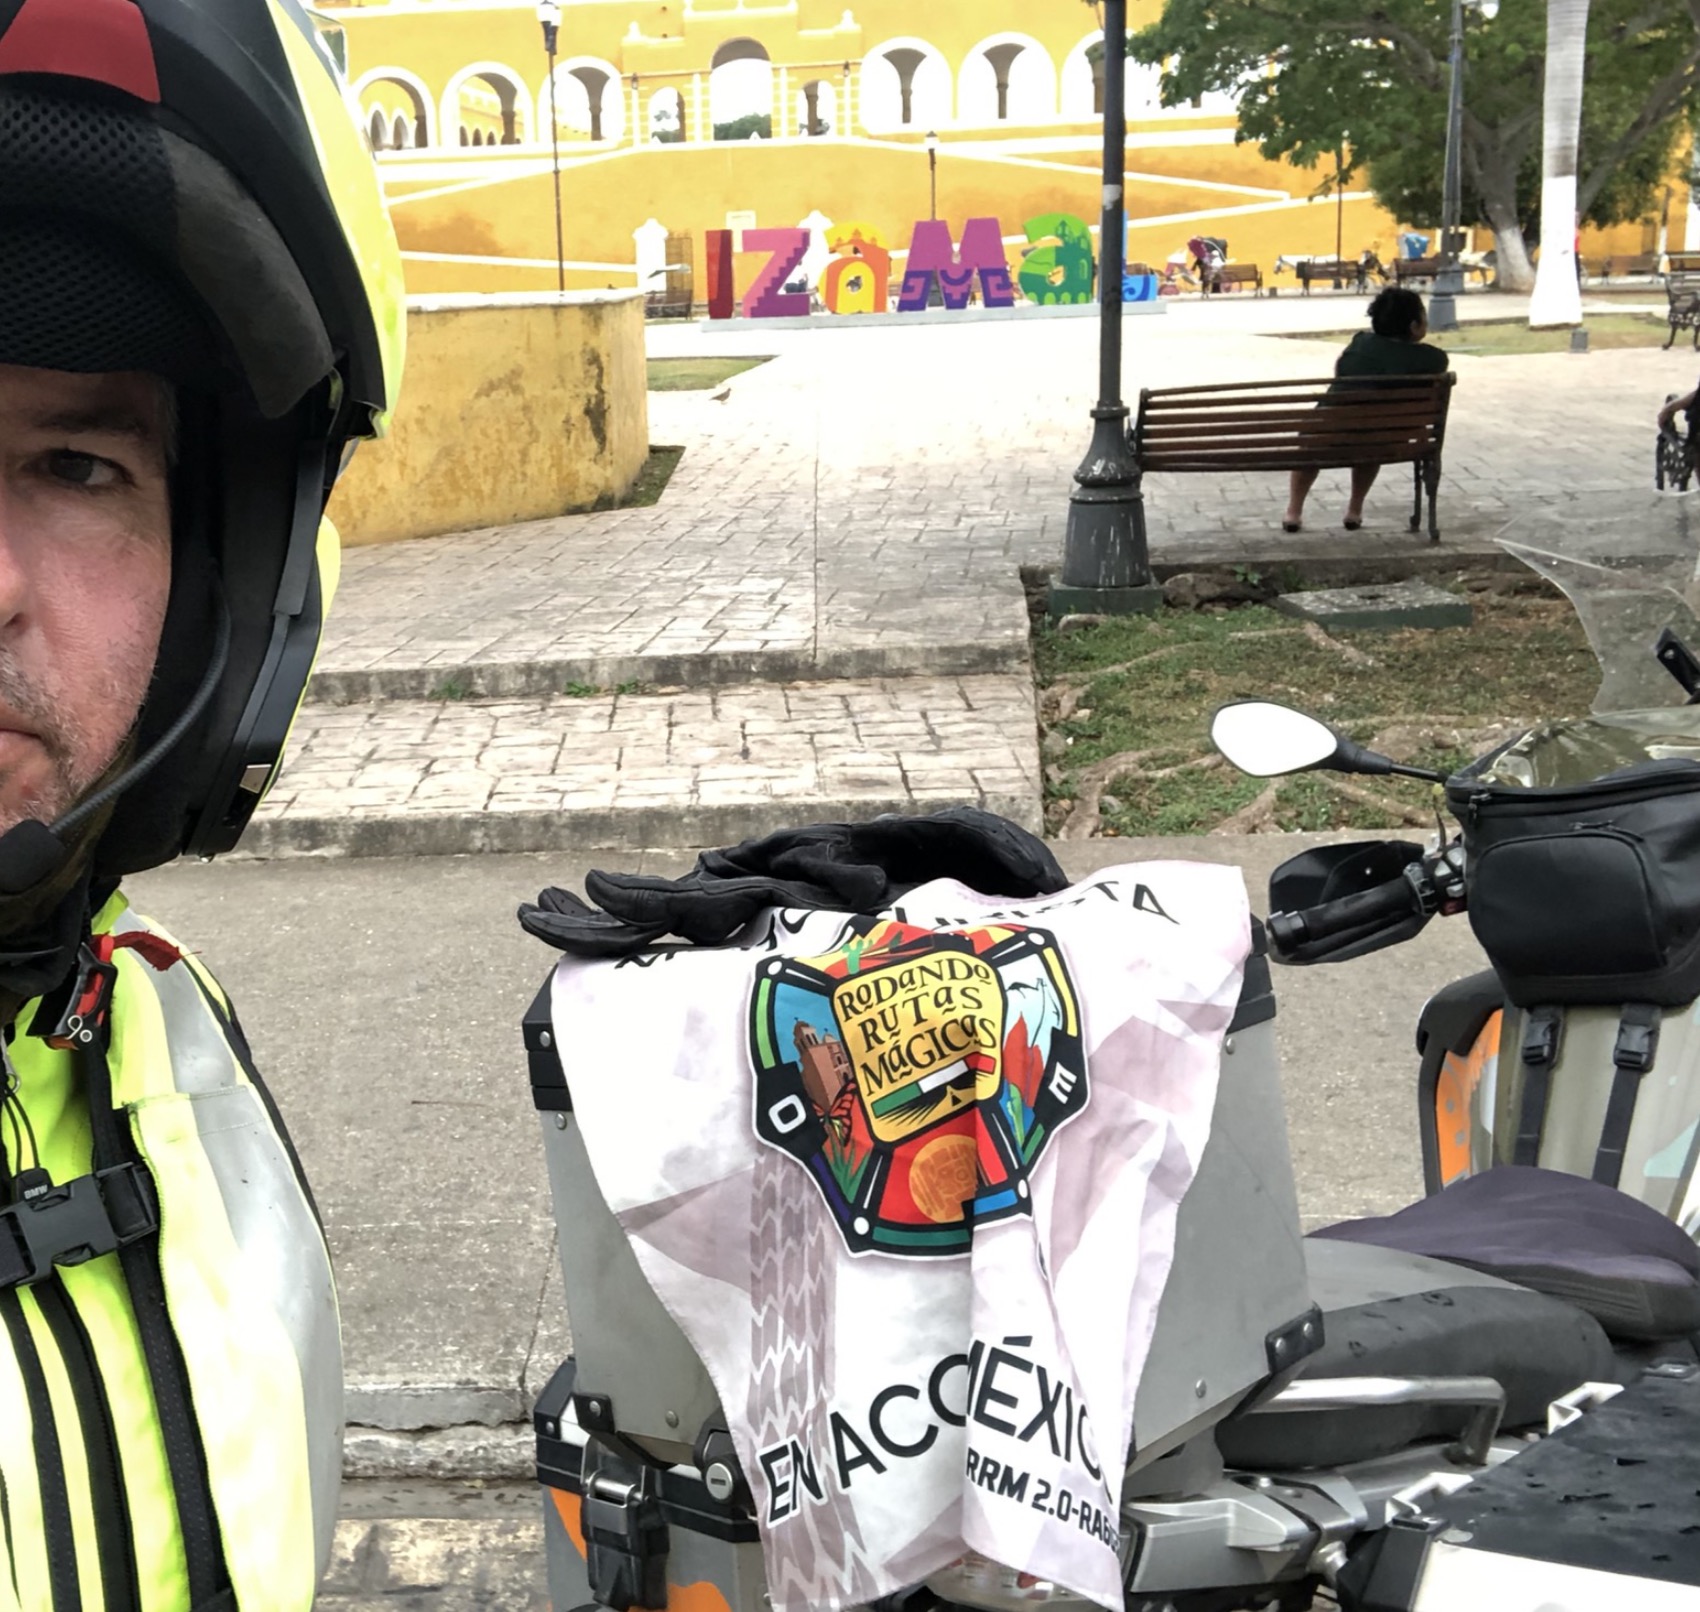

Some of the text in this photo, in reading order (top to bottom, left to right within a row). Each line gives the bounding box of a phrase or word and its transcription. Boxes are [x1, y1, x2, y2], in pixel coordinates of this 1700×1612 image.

[1048, 1061, 1077, 1105] E
[768, 1094, 807, 1134] O
[23, 1184, 49, 1200] BMW
[759, 1438, 824, 1523] EN
[967, 1335, 1113, 1505] ÉXIC
[966, 1446, 1030, 1504] RRM
